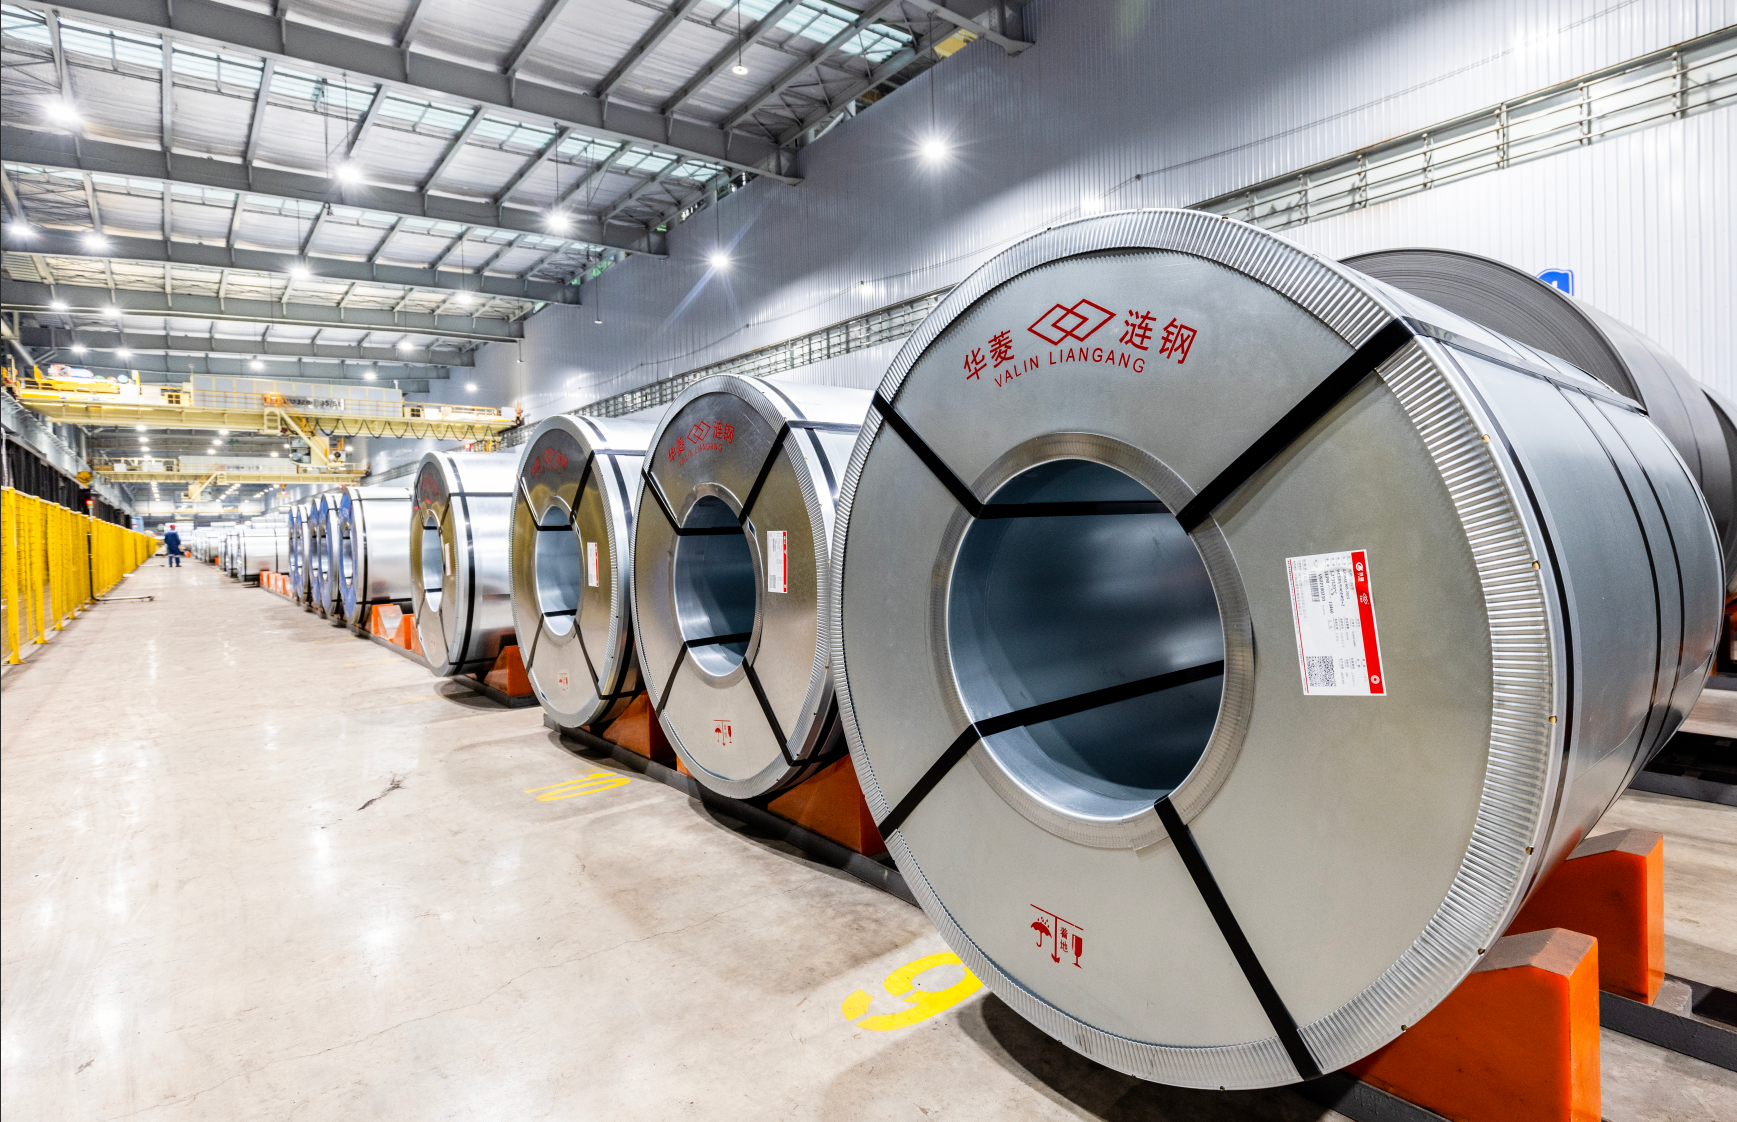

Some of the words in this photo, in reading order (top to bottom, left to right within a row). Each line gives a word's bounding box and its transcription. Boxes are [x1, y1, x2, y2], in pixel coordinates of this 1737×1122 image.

[963, 329, 1015, 380] 华菱
[1118, 309, 1198, 365] 涟钢
[994, 355, 1040, 387] VALIN
[1049, 347, 1146, 374] LIANGANG
